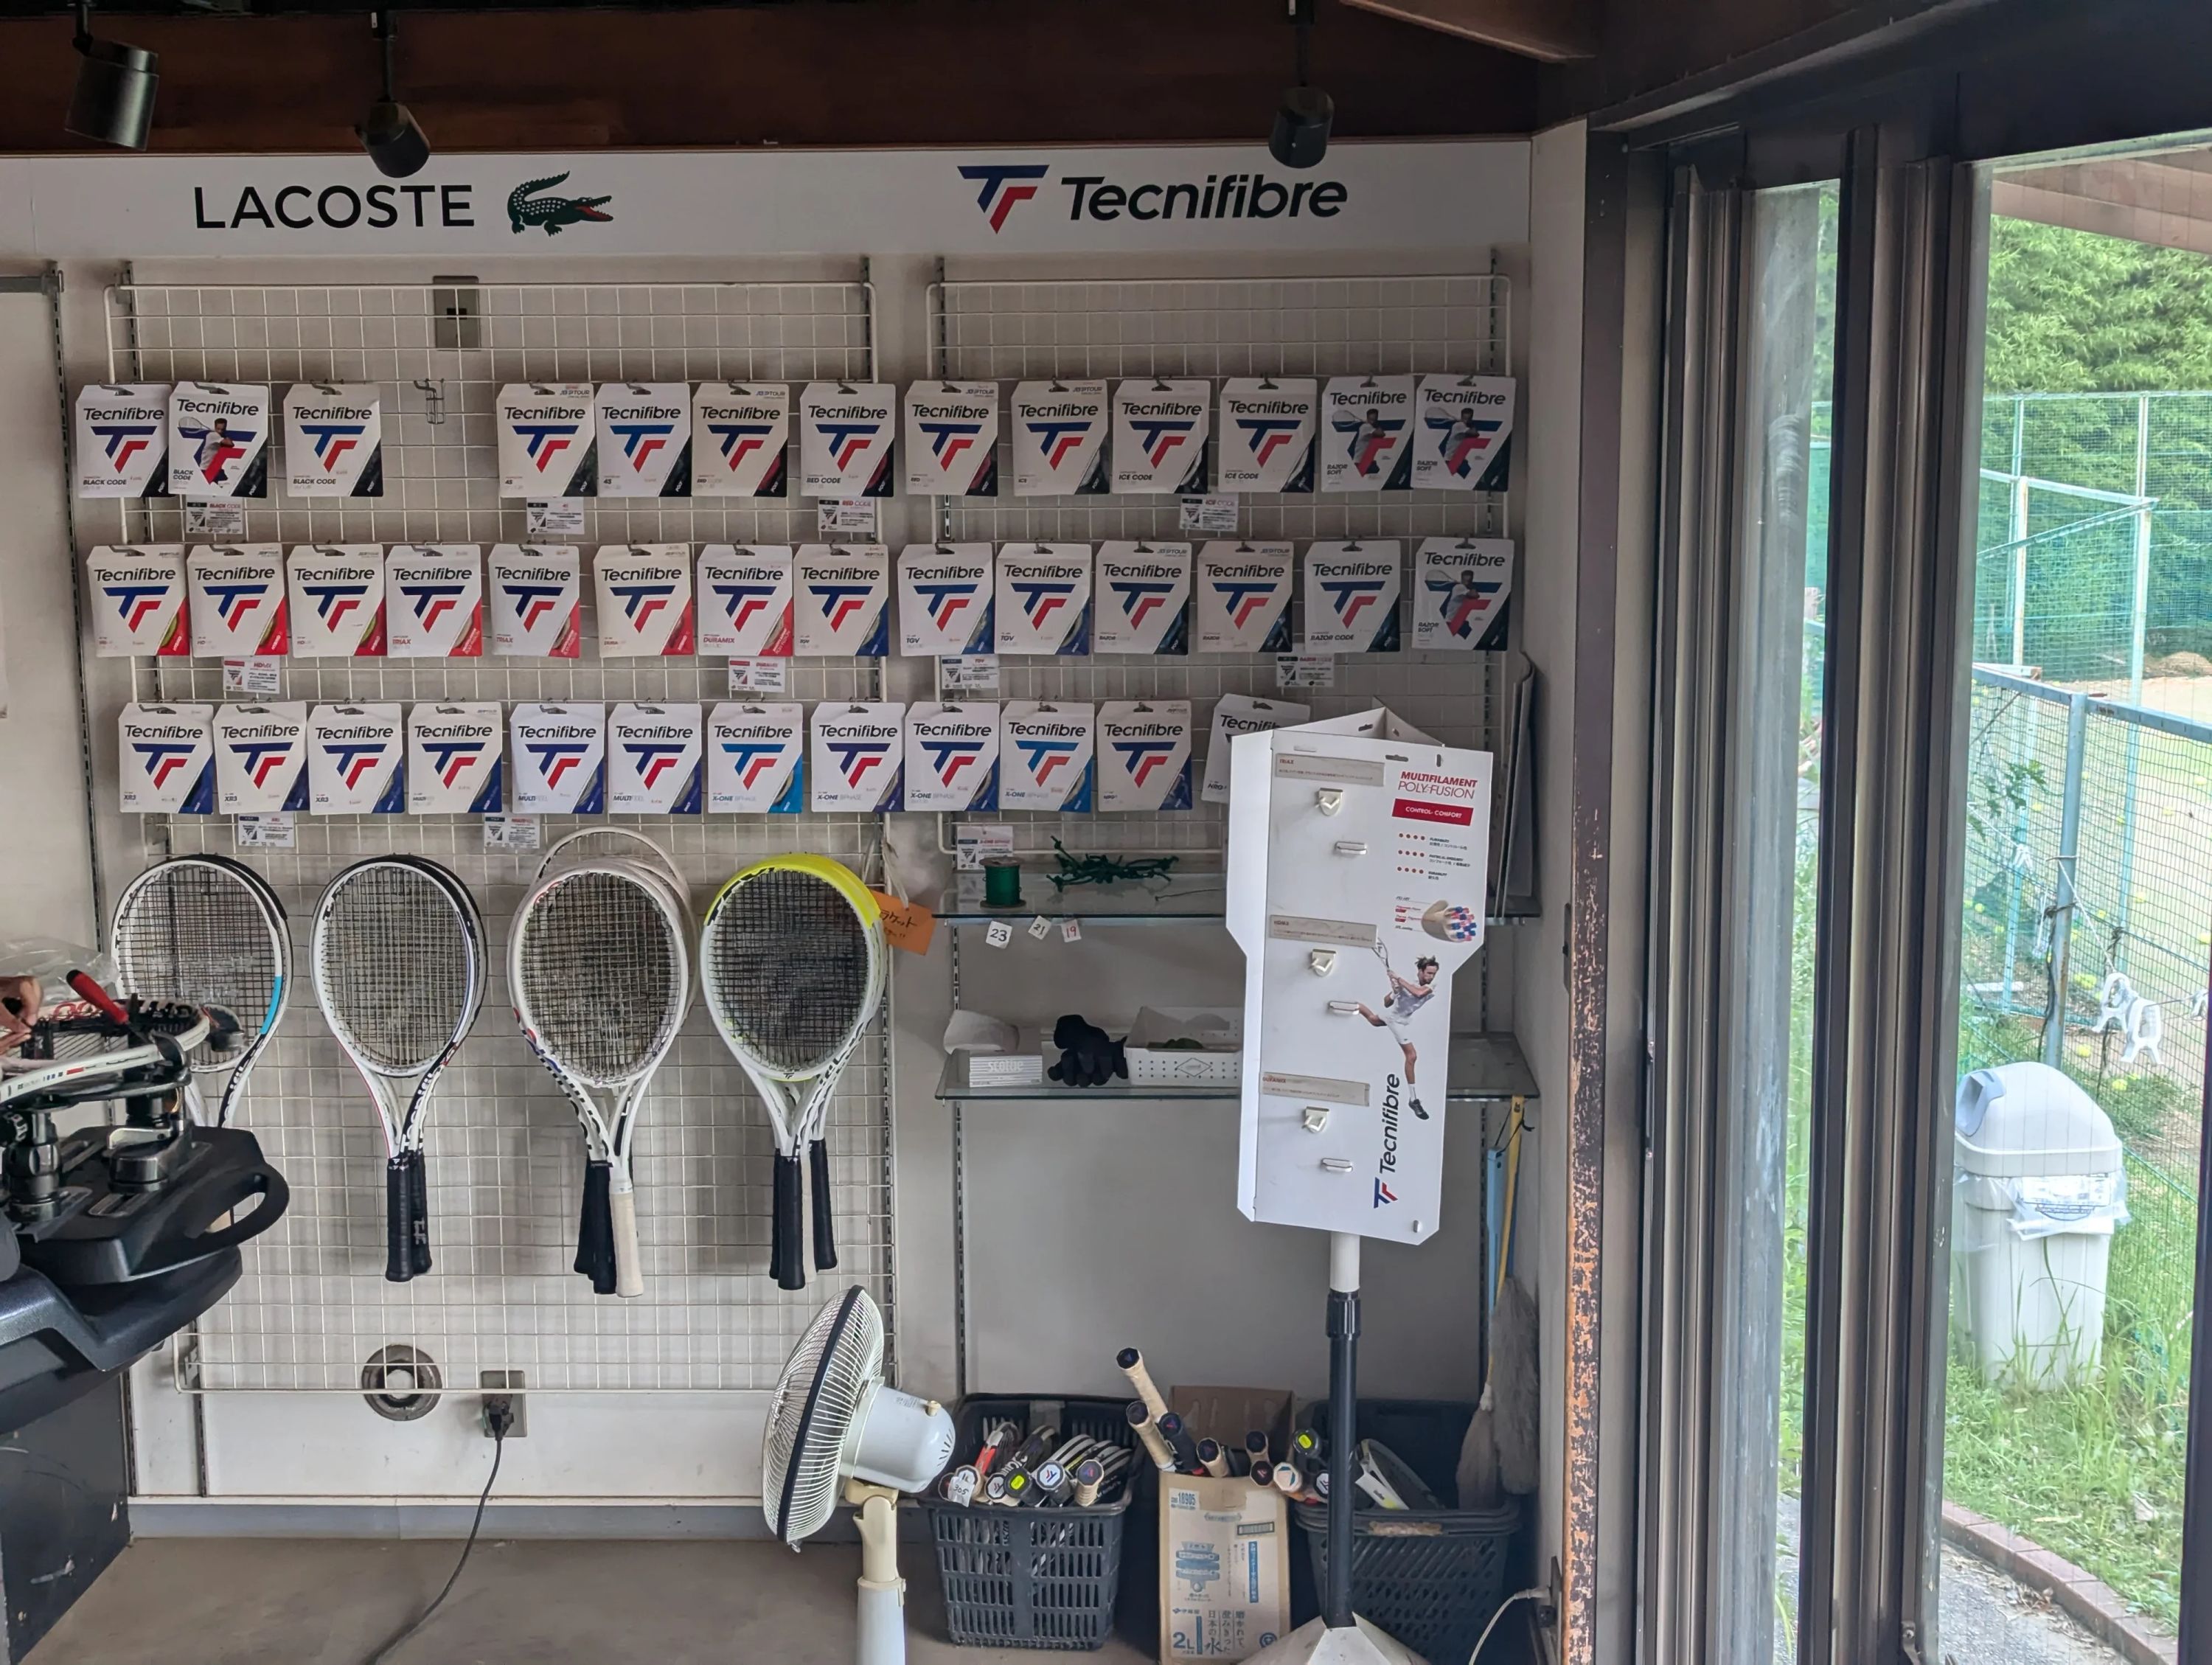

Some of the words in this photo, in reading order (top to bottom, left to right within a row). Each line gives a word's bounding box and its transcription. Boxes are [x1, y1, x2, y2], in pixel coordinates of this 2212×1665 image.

[1061, 174, 1348, 221] Tecnifibre
[194, 184, 474, 229] LACOSTE
[1330, 392, 1407, 405] Tecnifibre
[1425, 389, 1506, 405] Tecnifibre
[83, 407, 164, 420] Tecnifibre
[177, 398, 259, 416] Tecnifibre
[293, 406, 372, 420] Tecnifibre
[504, 406, 585, 420] Tecnifibre
[602, 406, 681, 420] Tecnifibre
[700, 406, 780, 420] Tecnifibre
[808, 405, 887, 419] Tecnifibre
[912, 404, 989, 418] Tecnifibre
[1018, 404, 1099, 417] Tecnifibre
[1122, 403, 1202, 416] Tecnifibre
[1228, 400, 1309, 414] Tecnifibre
[1425, 552, 1505, 566] Tecnifibre
[94, 568, 175, 581] Tecnifibre
[195, 567, 275, 581] Tecnifibre
[294, 568, 375, 581] Tecnifibre
[393, 567, 472, 581] Tecnifibre
[495, 566, 571, 581] Tecnifibre
[602, 568, 681, 581] Tecnifibre
[705, 566, 784, 580] Tecnifibre
[801, 567, 880, 580] Tecnifibre
[906, 566, 984, 580] Tecnifibre
[1004, 565, 1082, 578] Tecnifibre
[1103, 564, 1182, 577] Tecnifibre
[1206, 564, 1284, 577] Tecnifibre
[1312, 563, 1392, 576] Tecnifibre
[913, 723, 992, 737] Tecnifibre
[1009, 722, 1086, 737] Tecnifibre
[1220, 715, 1281, 731] Tecnifib
[125, 725, 203, 739] Tecnifibre
[221, 725, 299, 738] Tecnifibre
[316, 726, 394, 740] Tecnifibre
[414, 726, 493, 737] Tecnifibre
[518, 726, 597, 738] Tecnifibre
[616, 726, 693, 738] Tecnifibre
[714, 726, 793, 738] Tecnifibre
[819, 725, 897, 737] Tecnifibre
[1105, 724, 1183, 737] Tecnifibre
[1401, 771, 1478, 788] MULTIFILAMENT
[1398, 781, 1475, 799] POLY-FUSION
[990, 928, 1007, 942] 23
[1034, 923, 1046, 936] 21
[1066, 925, 1077, 937] 19
[1380, 1074, 1400, 1174] Tecnifibre
[953, 1484, 969, 1495] 305
[1204, 1610, 1222, 1655] 日本の水
[1172, 1632, 1194, 1650] 2L
